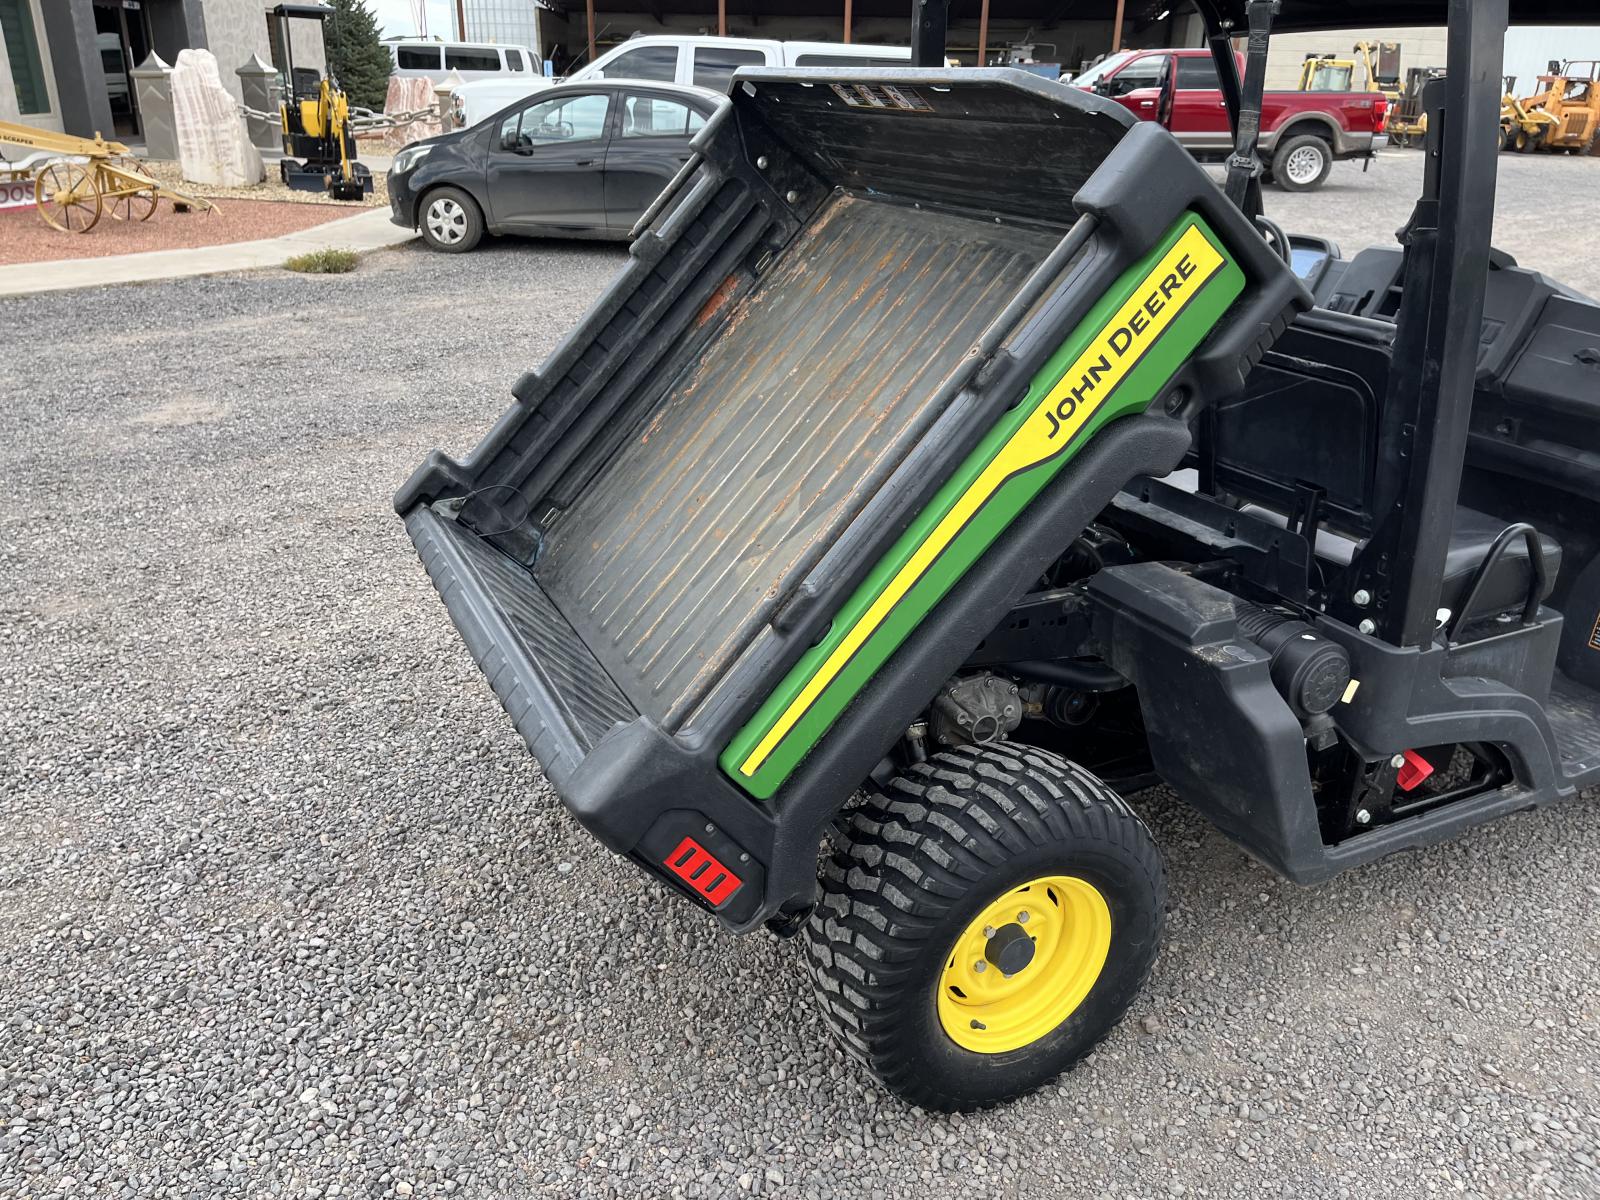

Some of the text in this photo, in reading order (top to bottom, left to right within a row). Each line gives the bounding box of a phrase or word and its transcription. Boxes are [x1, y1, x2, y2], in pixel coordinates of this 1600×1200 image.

[3, 135, 34, 145] SCRAPER
[1045, 253, 1197, 439] JOHN DEERE
